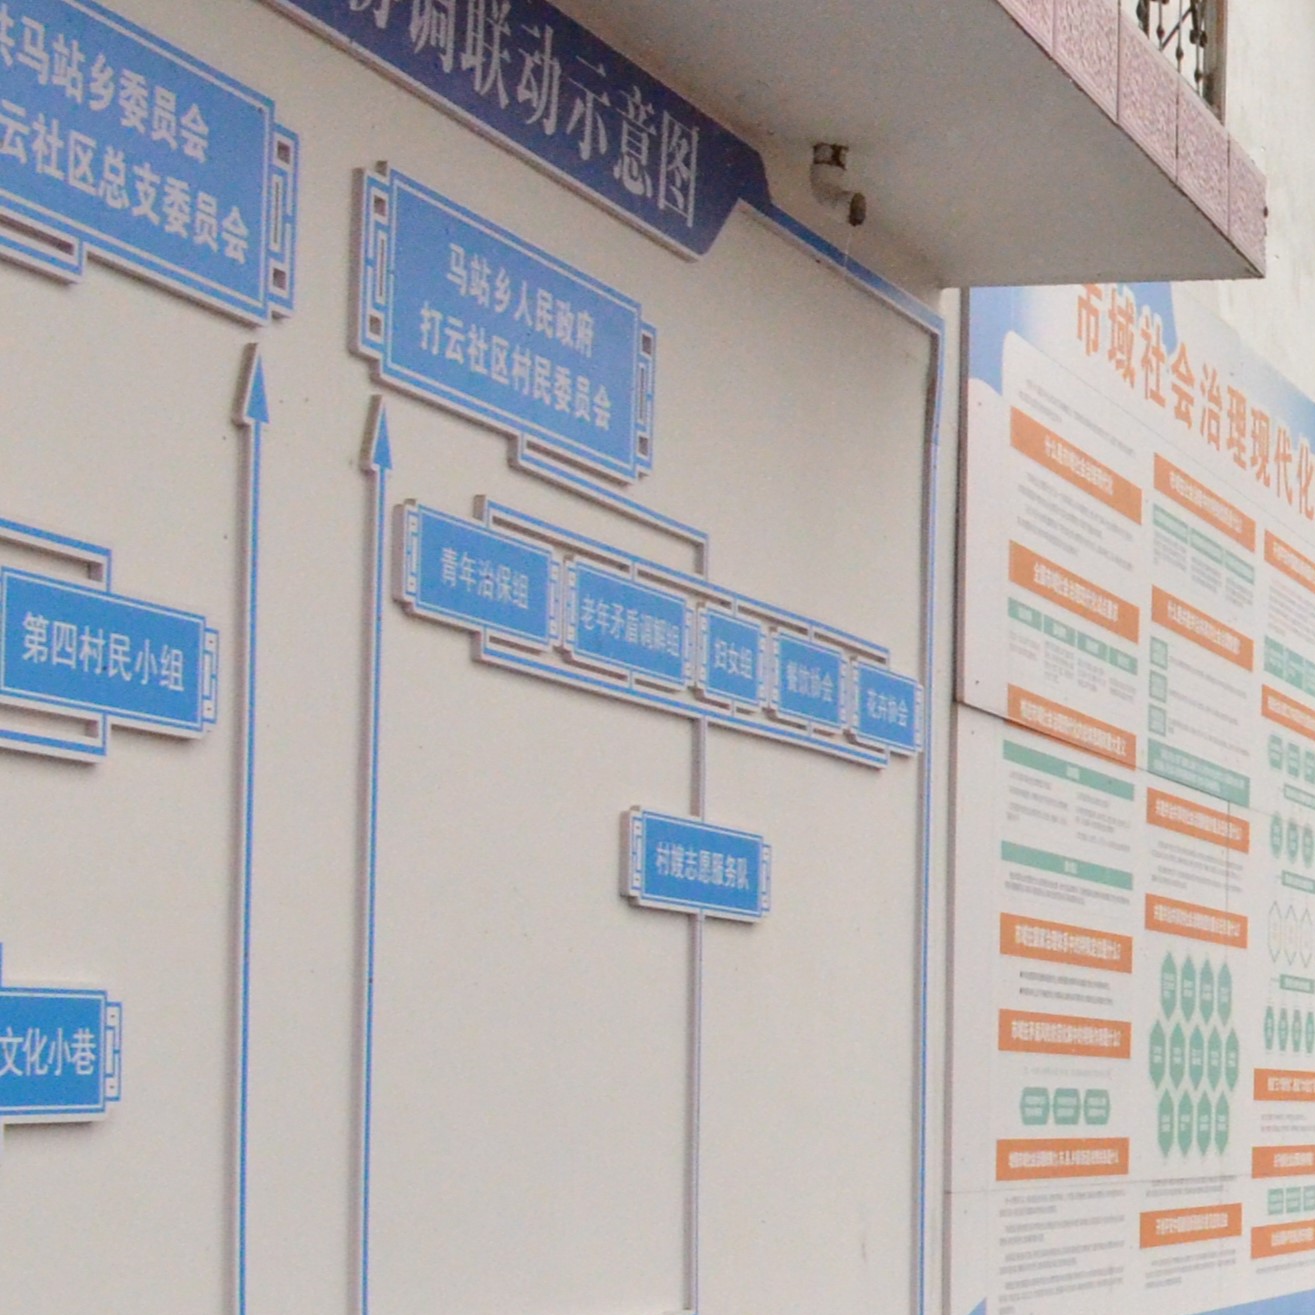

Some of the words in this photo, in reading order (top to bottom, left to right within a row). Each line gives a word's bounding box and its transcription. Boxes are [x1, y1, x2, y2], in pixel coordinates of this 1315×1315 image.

[349, 0, 699, 228] 调联动示意图
[447, 243, 594, 358] 马站乡人民政府
[420, 301, 611, 431] 打云社区村民委员会
[440, 547, 529, 610] 青年治保组
[22, 611, 185, 693] 第四村民小组
[0, 1026, 97, 1078] 文化小巷
